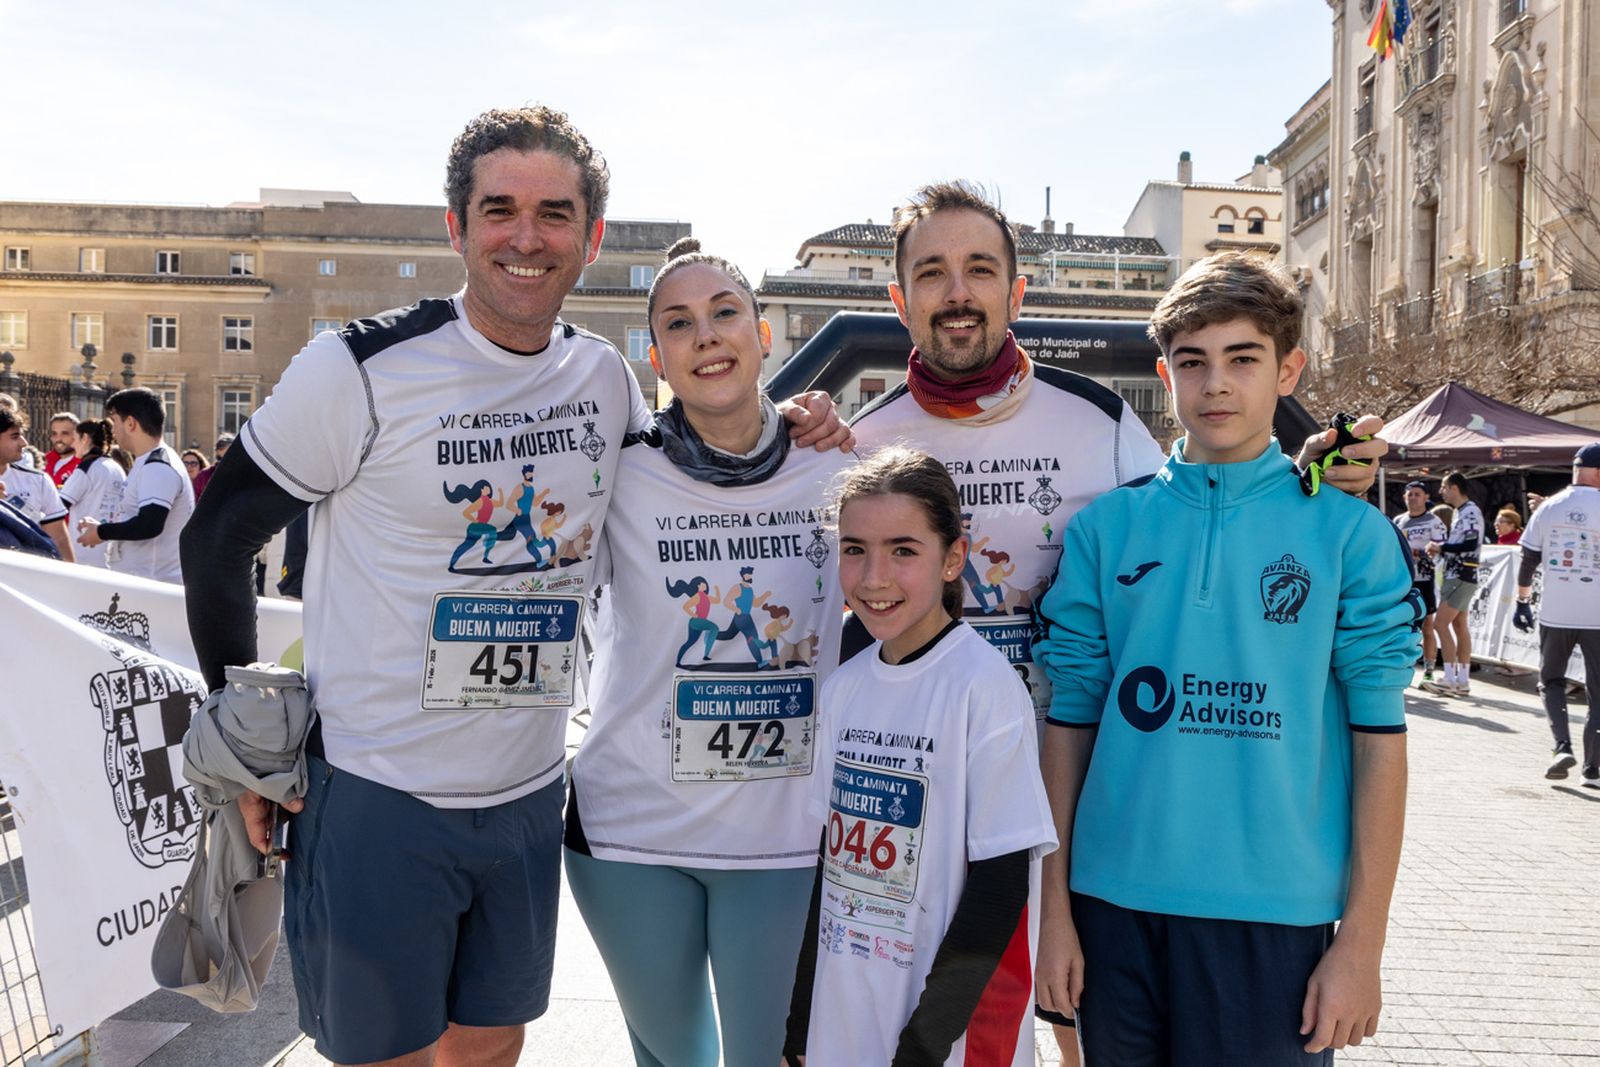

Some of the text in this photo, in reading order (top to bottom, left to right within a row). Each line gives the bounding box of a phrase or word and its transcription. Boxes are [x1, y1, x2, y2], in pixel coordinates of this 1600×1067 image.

[1042, 337, 1091, 349] Municipal
[1093, 338, 1107, 348] de
[1039, 348, 1053, 358] de
[1054, 348, 1080, 359] Jaén
[439, 400, 600, 430] VI CARRERA CAMINATA
[437, 428, 578, 466] BUENA MUERTE
[979, 457, 1061, 473] CAMINATA
[656, 517, 671, 530] VI
[676, 512, 752, 530] CARRERA
[658, 534, 803, 562] BUENA MUERTE
[1261, 563, 1312, 579] AVANZA
[452, 603, 564, 615] VI CARRERA CAMINATA
[449, 619, 541, 638] BUENA MUERTE
[470, 645, 539, 686] 451
[693, 682, 802, 695] VI CARRERA CAMINATA
[1182, 673, 1267, 704] Energy
[96, 680, 111, 726] MUY NOBLE
[692, 699, 781, 716] BUENA MUERTE
[1179, 700, 1282, 729] Advisors
[707, 720, 785, 760] 472
[884, 733, 934, 753] CAMINATA
[855, 775, 908, 796] CAMINATA
[840, 789, 883, 815] MUERTE
